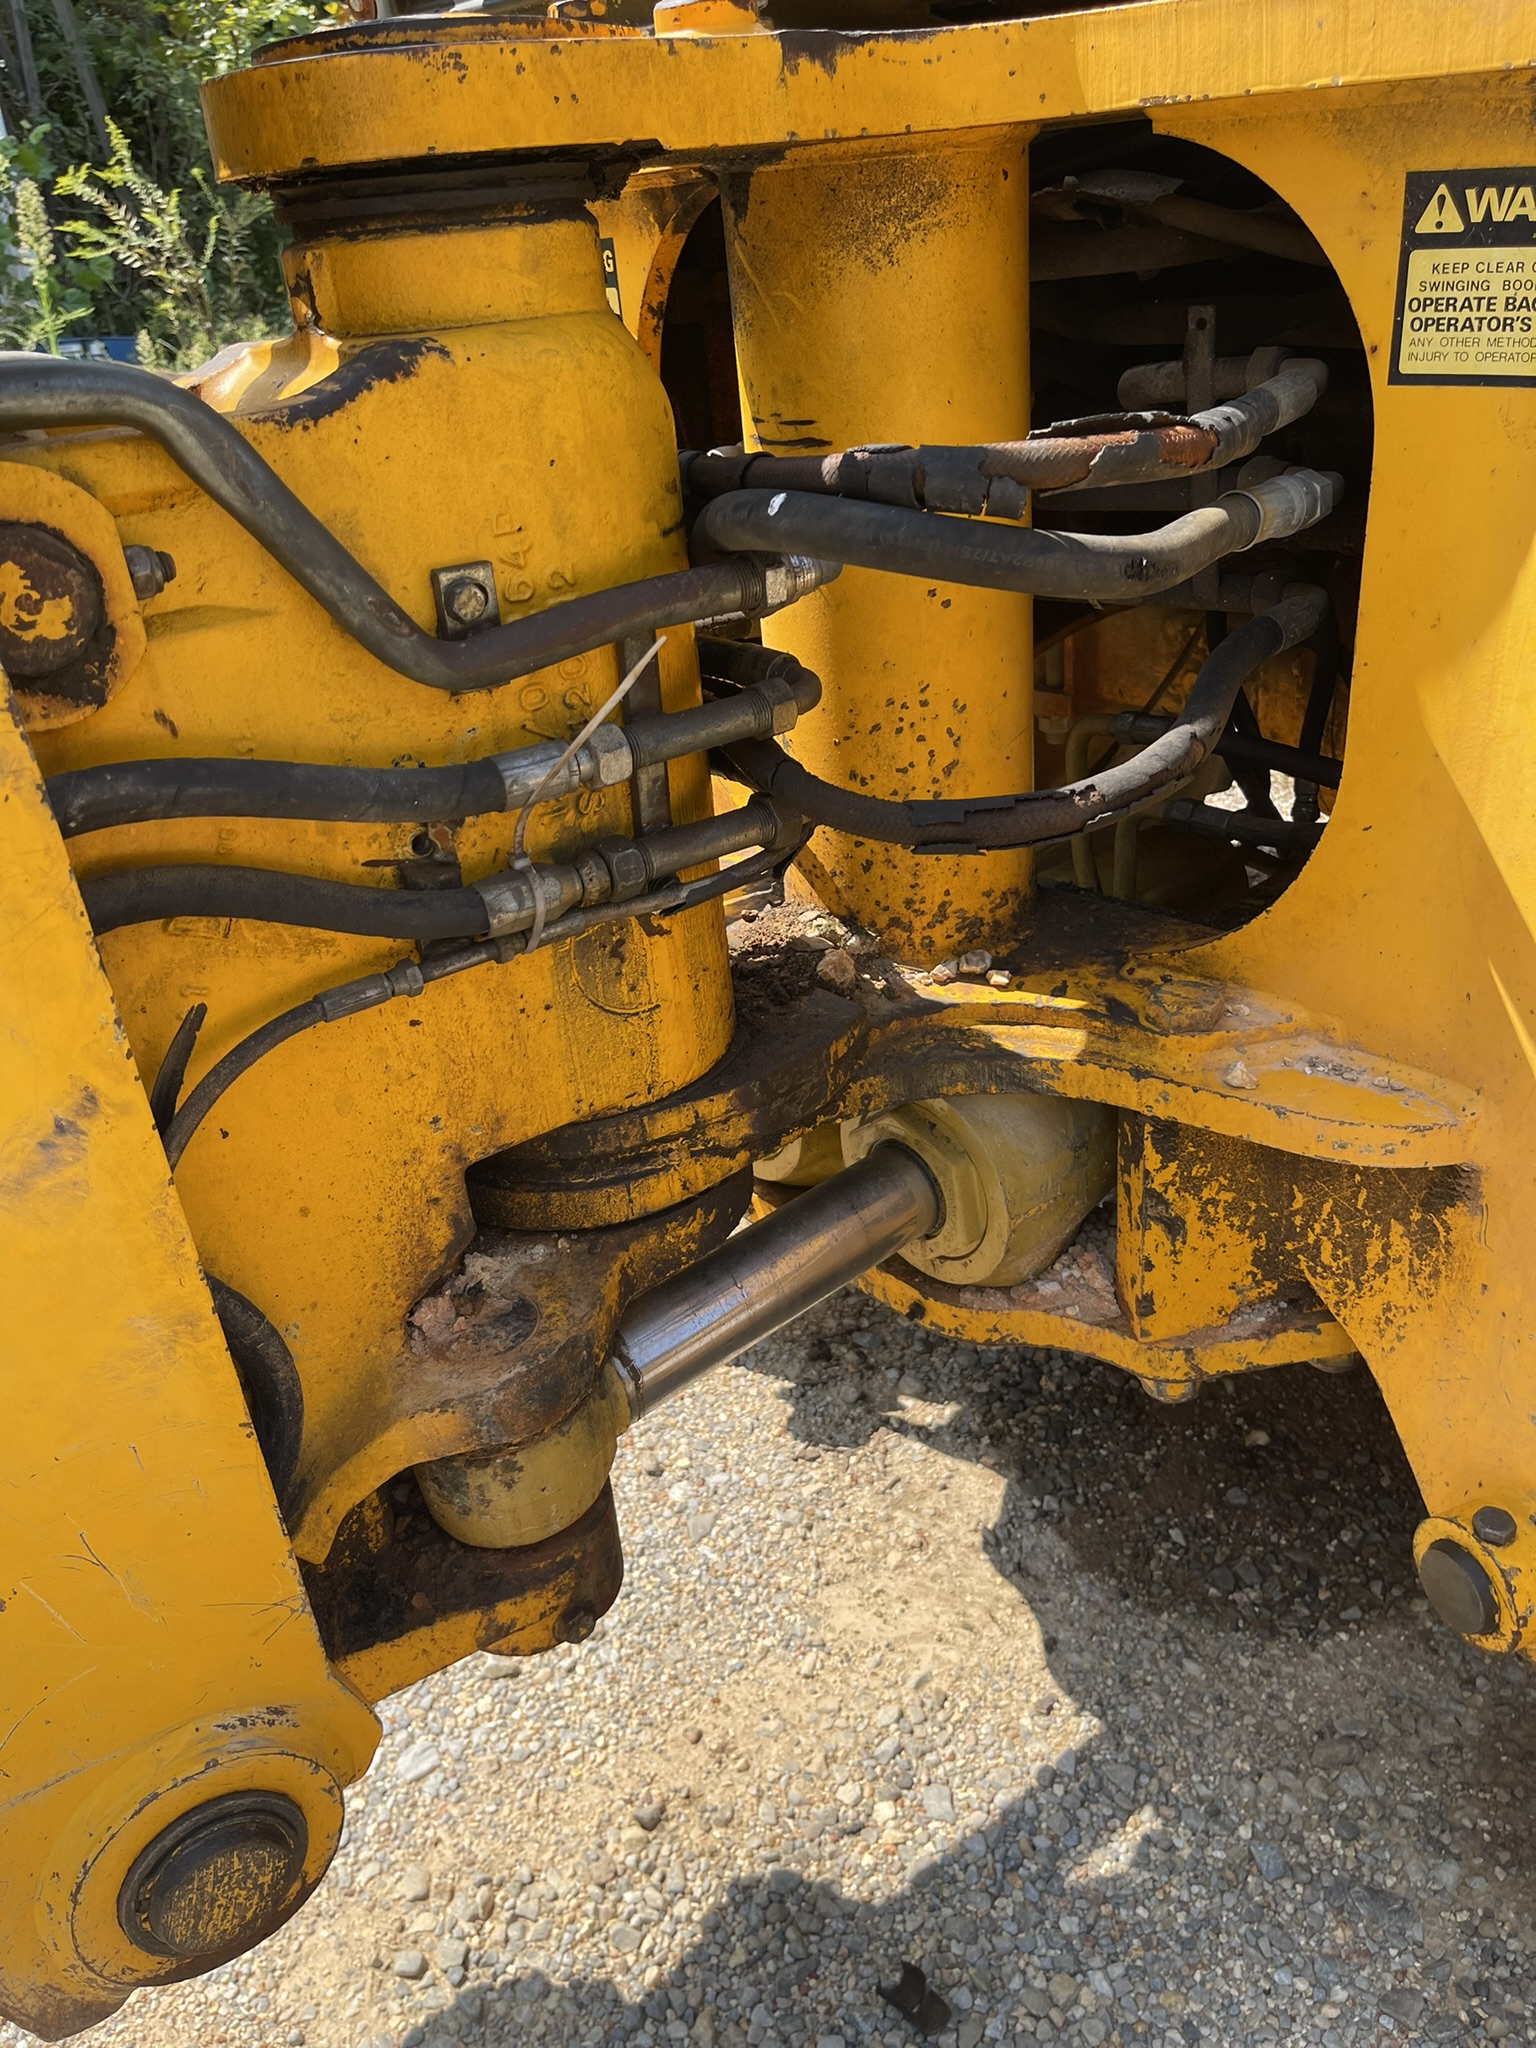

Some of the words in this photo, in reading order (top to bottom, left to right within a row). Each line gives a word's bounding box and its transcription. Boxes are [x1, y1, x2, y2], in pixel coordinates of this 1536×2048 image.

[1465, 186, 1536, 223] WA
[603, 250, 614, 273] G
[1432, 262, 1470, 275] KEEP
[1475, 261, 1525, 274] CLEAR
[1419, 279, 1491, 292] SWINGING
[1502, 279, 1536, 291] BOO
[1408, 296, 1498, 313] OPERATE
[1410, 316, 1532, 333] OPERATOR'S
[1409, 337, 1434, 348] ANY
[1439, 336, 1480, 348] OTHER
[1407, 351, 1450, 362] INJURY
[1454, 351, 1470, 362] TO
